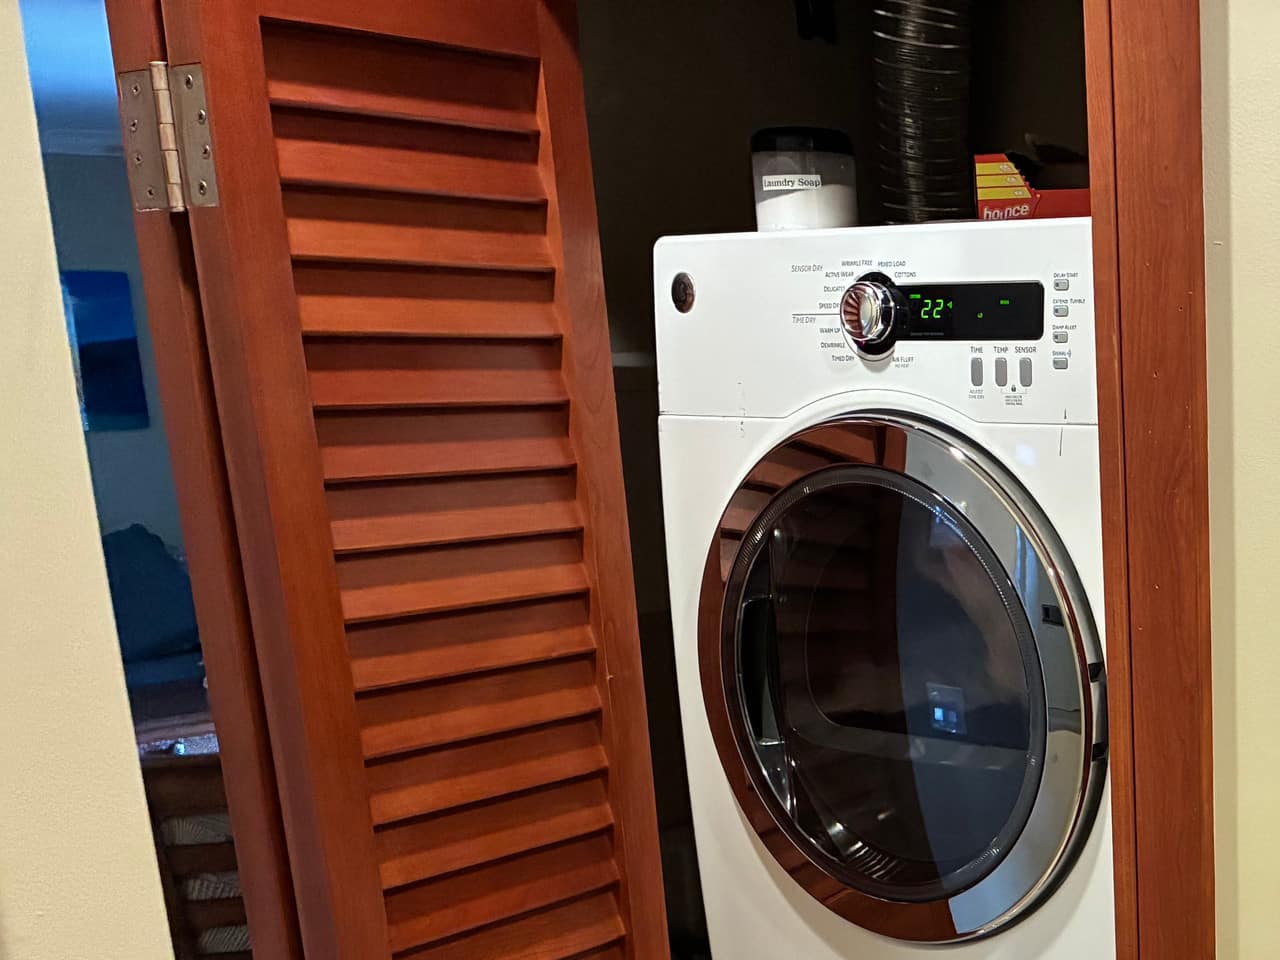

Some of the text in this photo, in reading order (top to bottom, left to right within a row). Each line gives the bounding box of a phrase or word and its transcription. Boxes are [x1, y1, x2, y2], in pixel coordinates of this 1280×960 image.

[798, 178, 820, 188] Soap
[812, 264, 824, 272] DRY
[920, 299, 944, 319] 22
[804, 316, 816, 324] DRY
[970, 345, 1037, 354] TIME TEMP SENSOR
